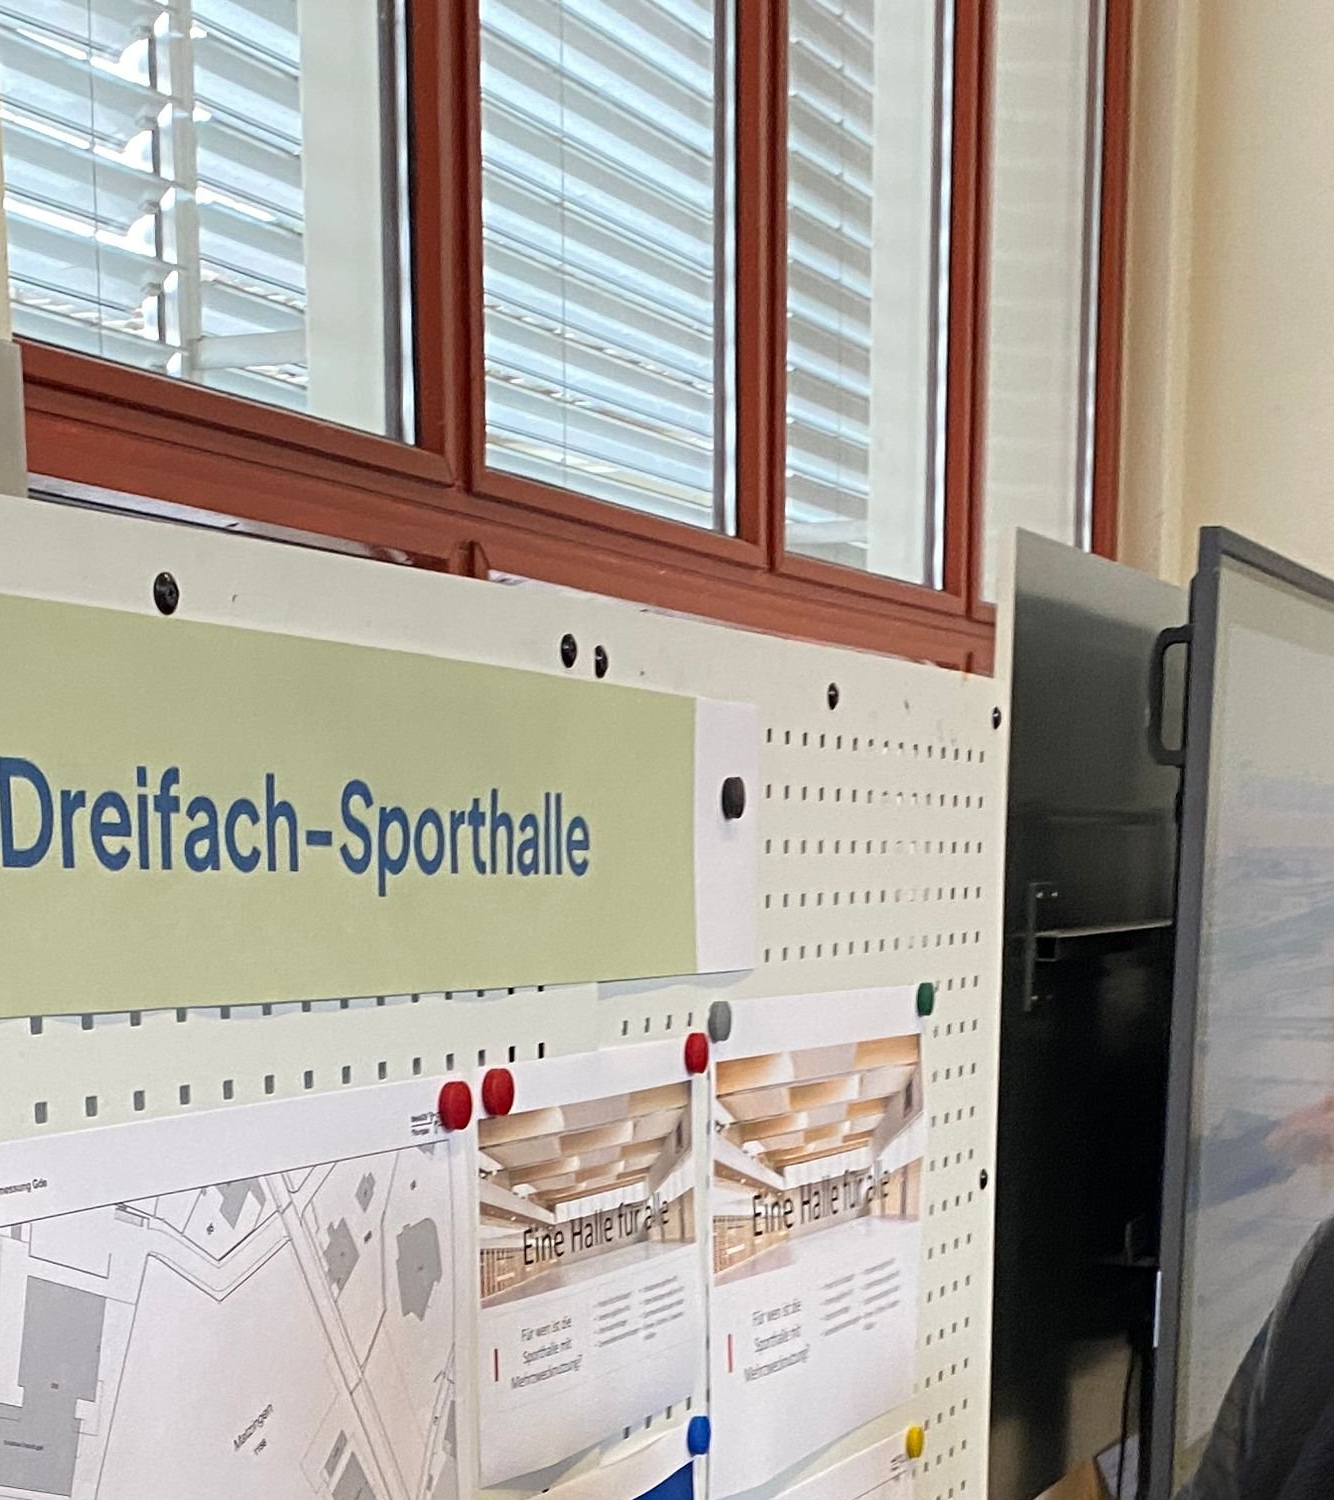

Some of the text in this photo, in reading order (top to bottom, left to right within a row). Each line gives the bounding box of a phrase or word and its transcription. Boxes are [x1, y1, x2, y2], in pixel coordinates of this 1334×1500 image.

[523, 1227, 565, 1266] Eine
[570, 1208, 613, 1253] Halle
[643, 1192, 670, 1232] alle
[753, 1193, 794, 1237] Eine
[800, 1175, 839, 1225] Halle
